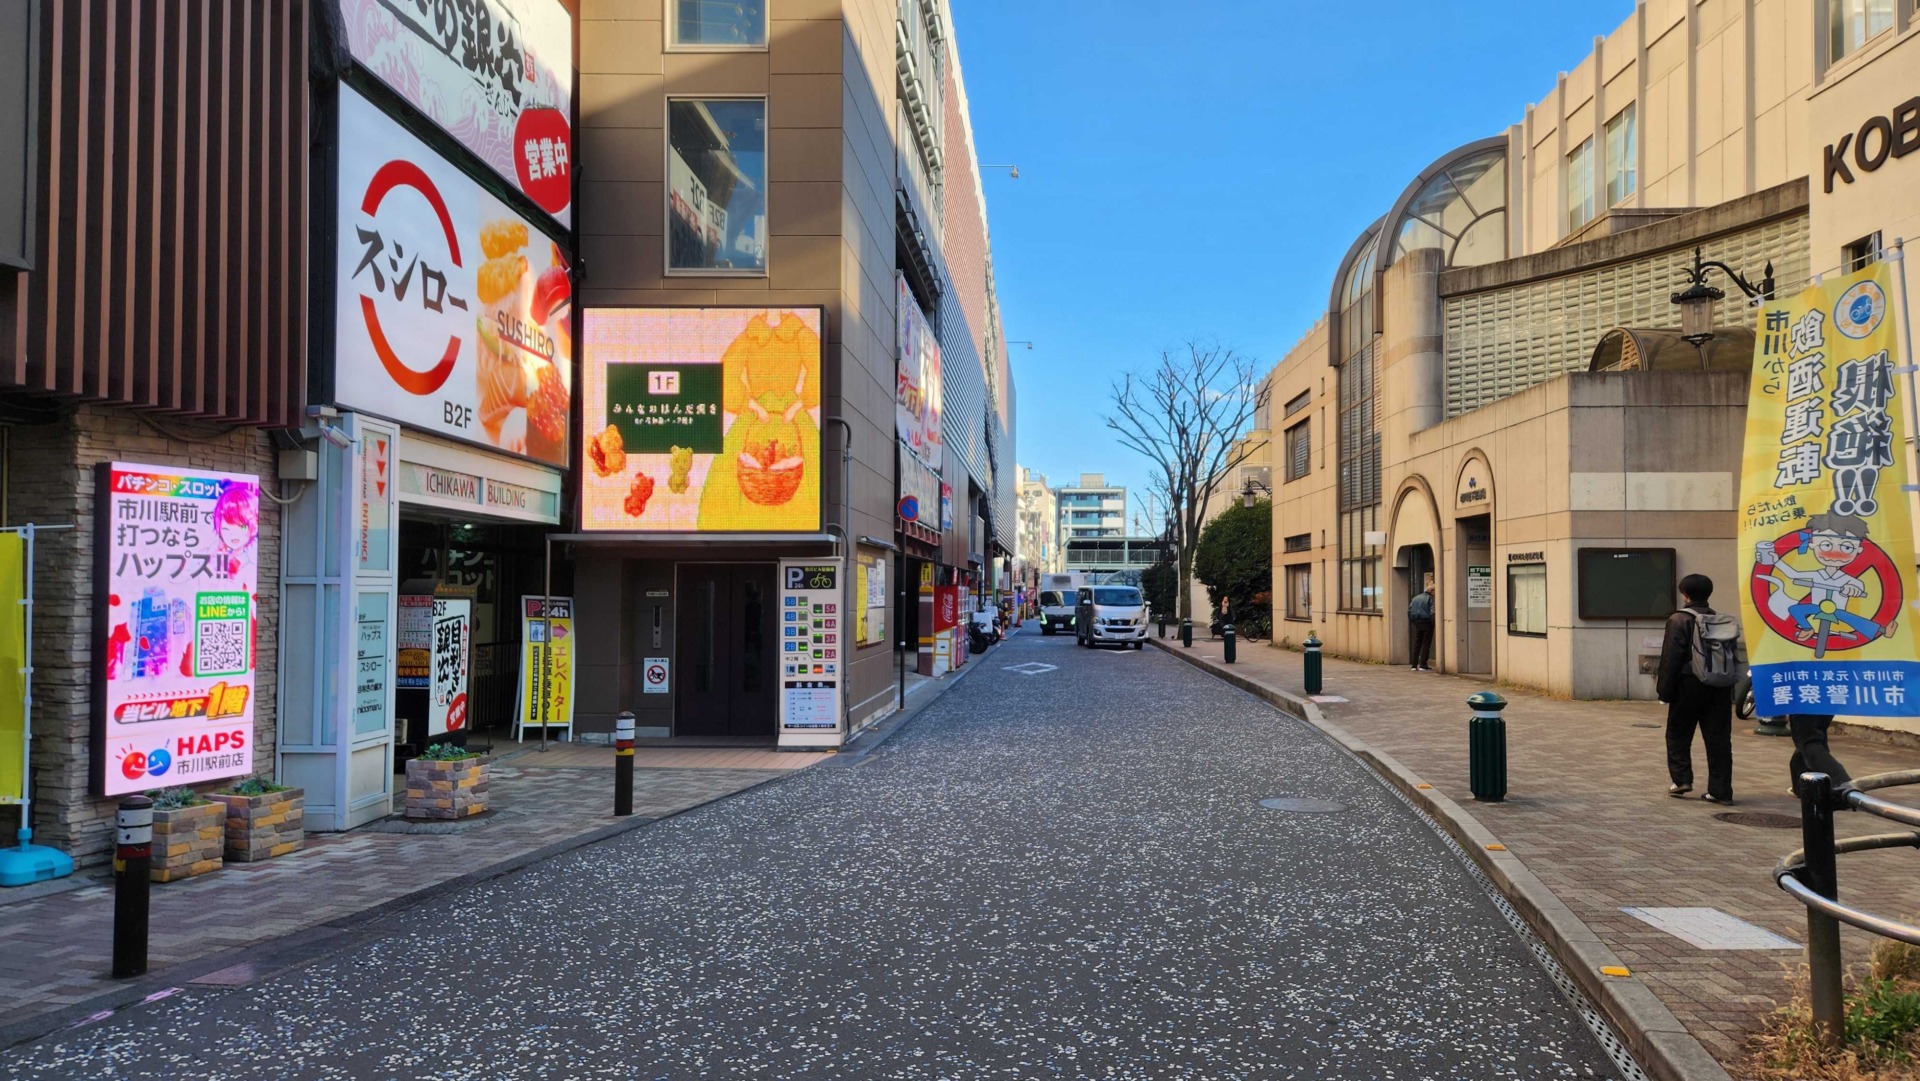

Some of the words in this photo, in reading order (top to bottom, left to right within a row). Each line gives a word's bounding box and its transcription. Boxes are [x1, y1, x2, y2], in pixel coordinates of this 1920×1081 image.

[524, 136, 569, 181] 営業中
[351, 224, 469, 314] スシロー
[496, 309, 555, 360] SUSHIRO
[443, 400, 472, 429] B2F
[117, 474, 224, 497] パチンコ・スロット
[426, 472, 476, 500] ICHIKAWA
[487, 484, 526, 509] BUILDING
[117, 498, 215, 525] 市川駅前で
[117, 524, 200, 548] 打つなら
[361, 502, 369, 562] ENTRANCE
[787, 567, 804, 588] P
[199, 595, 246, 605] お店の情報は
[433, 601, 447, 616] B2F
[943, 593, 954, 623] Coca-Cola
[360, 662, 382, 672] スシロー
[554, 646, 568, 721] エレベーター
[120, 682, 249, 723] 当ビル地下1階
[177, 730, 245, 757] HAPS
[177, 753, 244, 775] 市川駅前店
